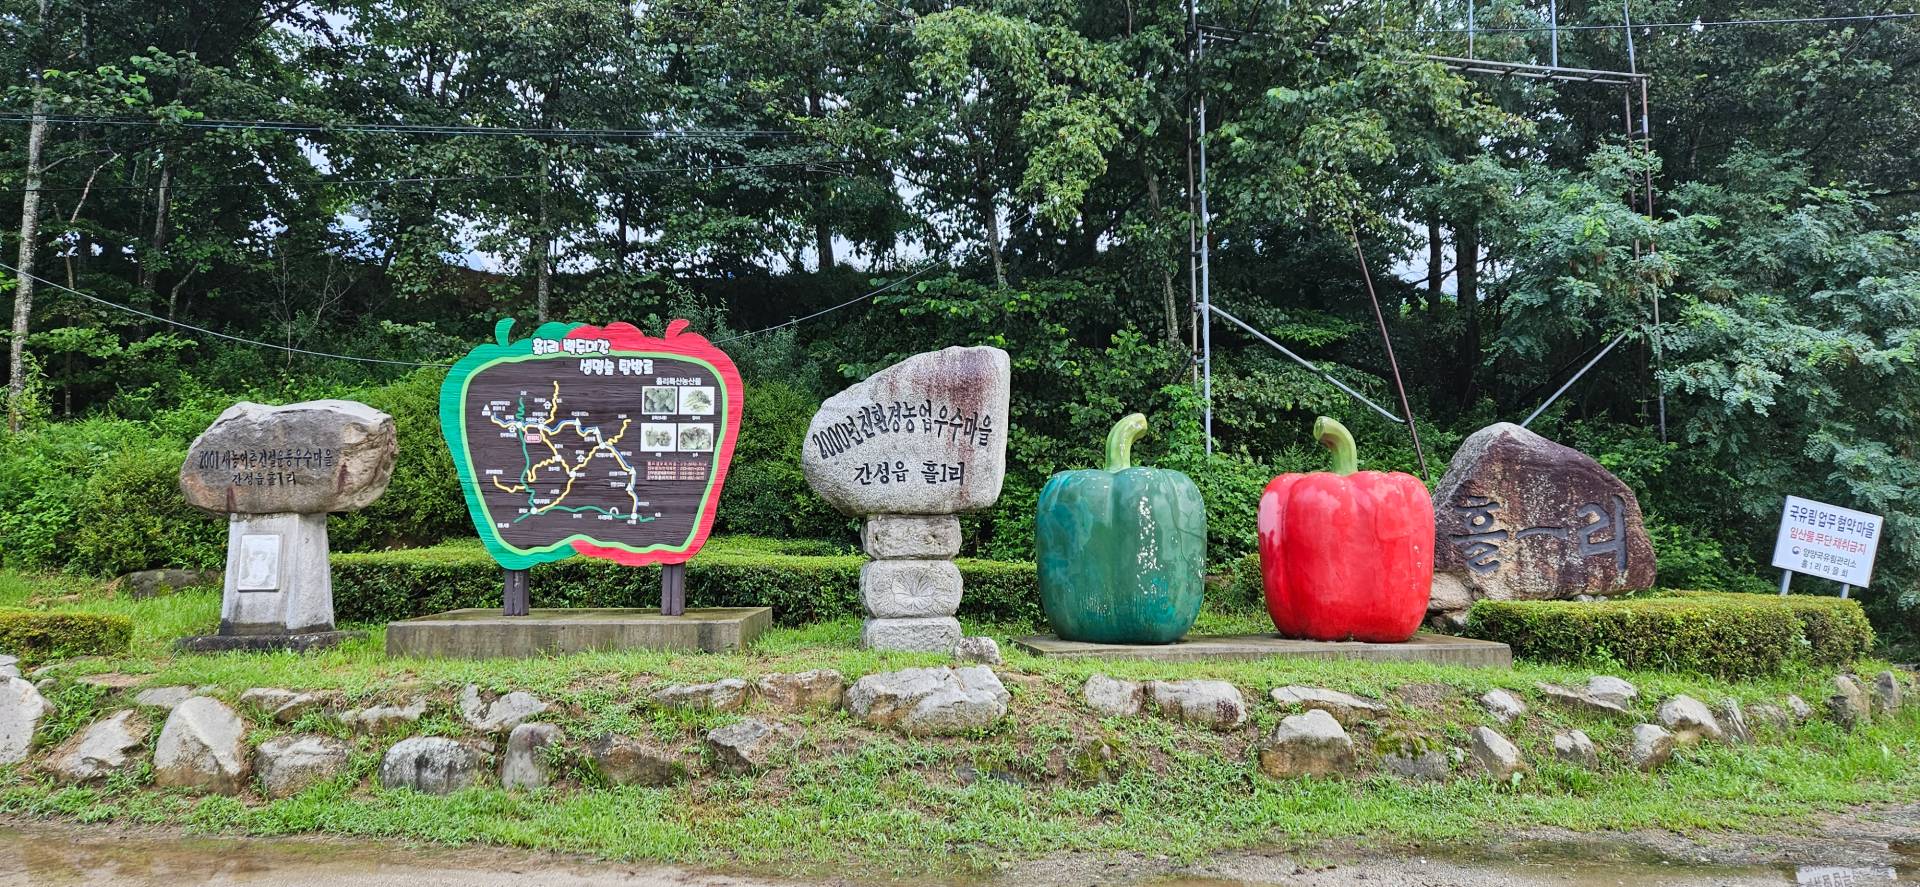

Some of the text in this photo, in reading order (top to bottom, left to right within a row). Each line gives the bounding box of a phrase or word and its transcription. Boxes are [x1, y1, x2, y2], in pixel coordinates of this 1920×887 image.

[619, 358, 654, 375] 탐방로
[200, 450, 219, 469] 2001
[232, 472, 264, 486] 간성읍
[853, 460, 965, 485] 간성읍 흘1리
[1790, 505, 1875, 539] 국유림 업무 협약 마을
[1790, 527, 1815, 543] 임산물
[1815, 532, 1833, 547] 무단
